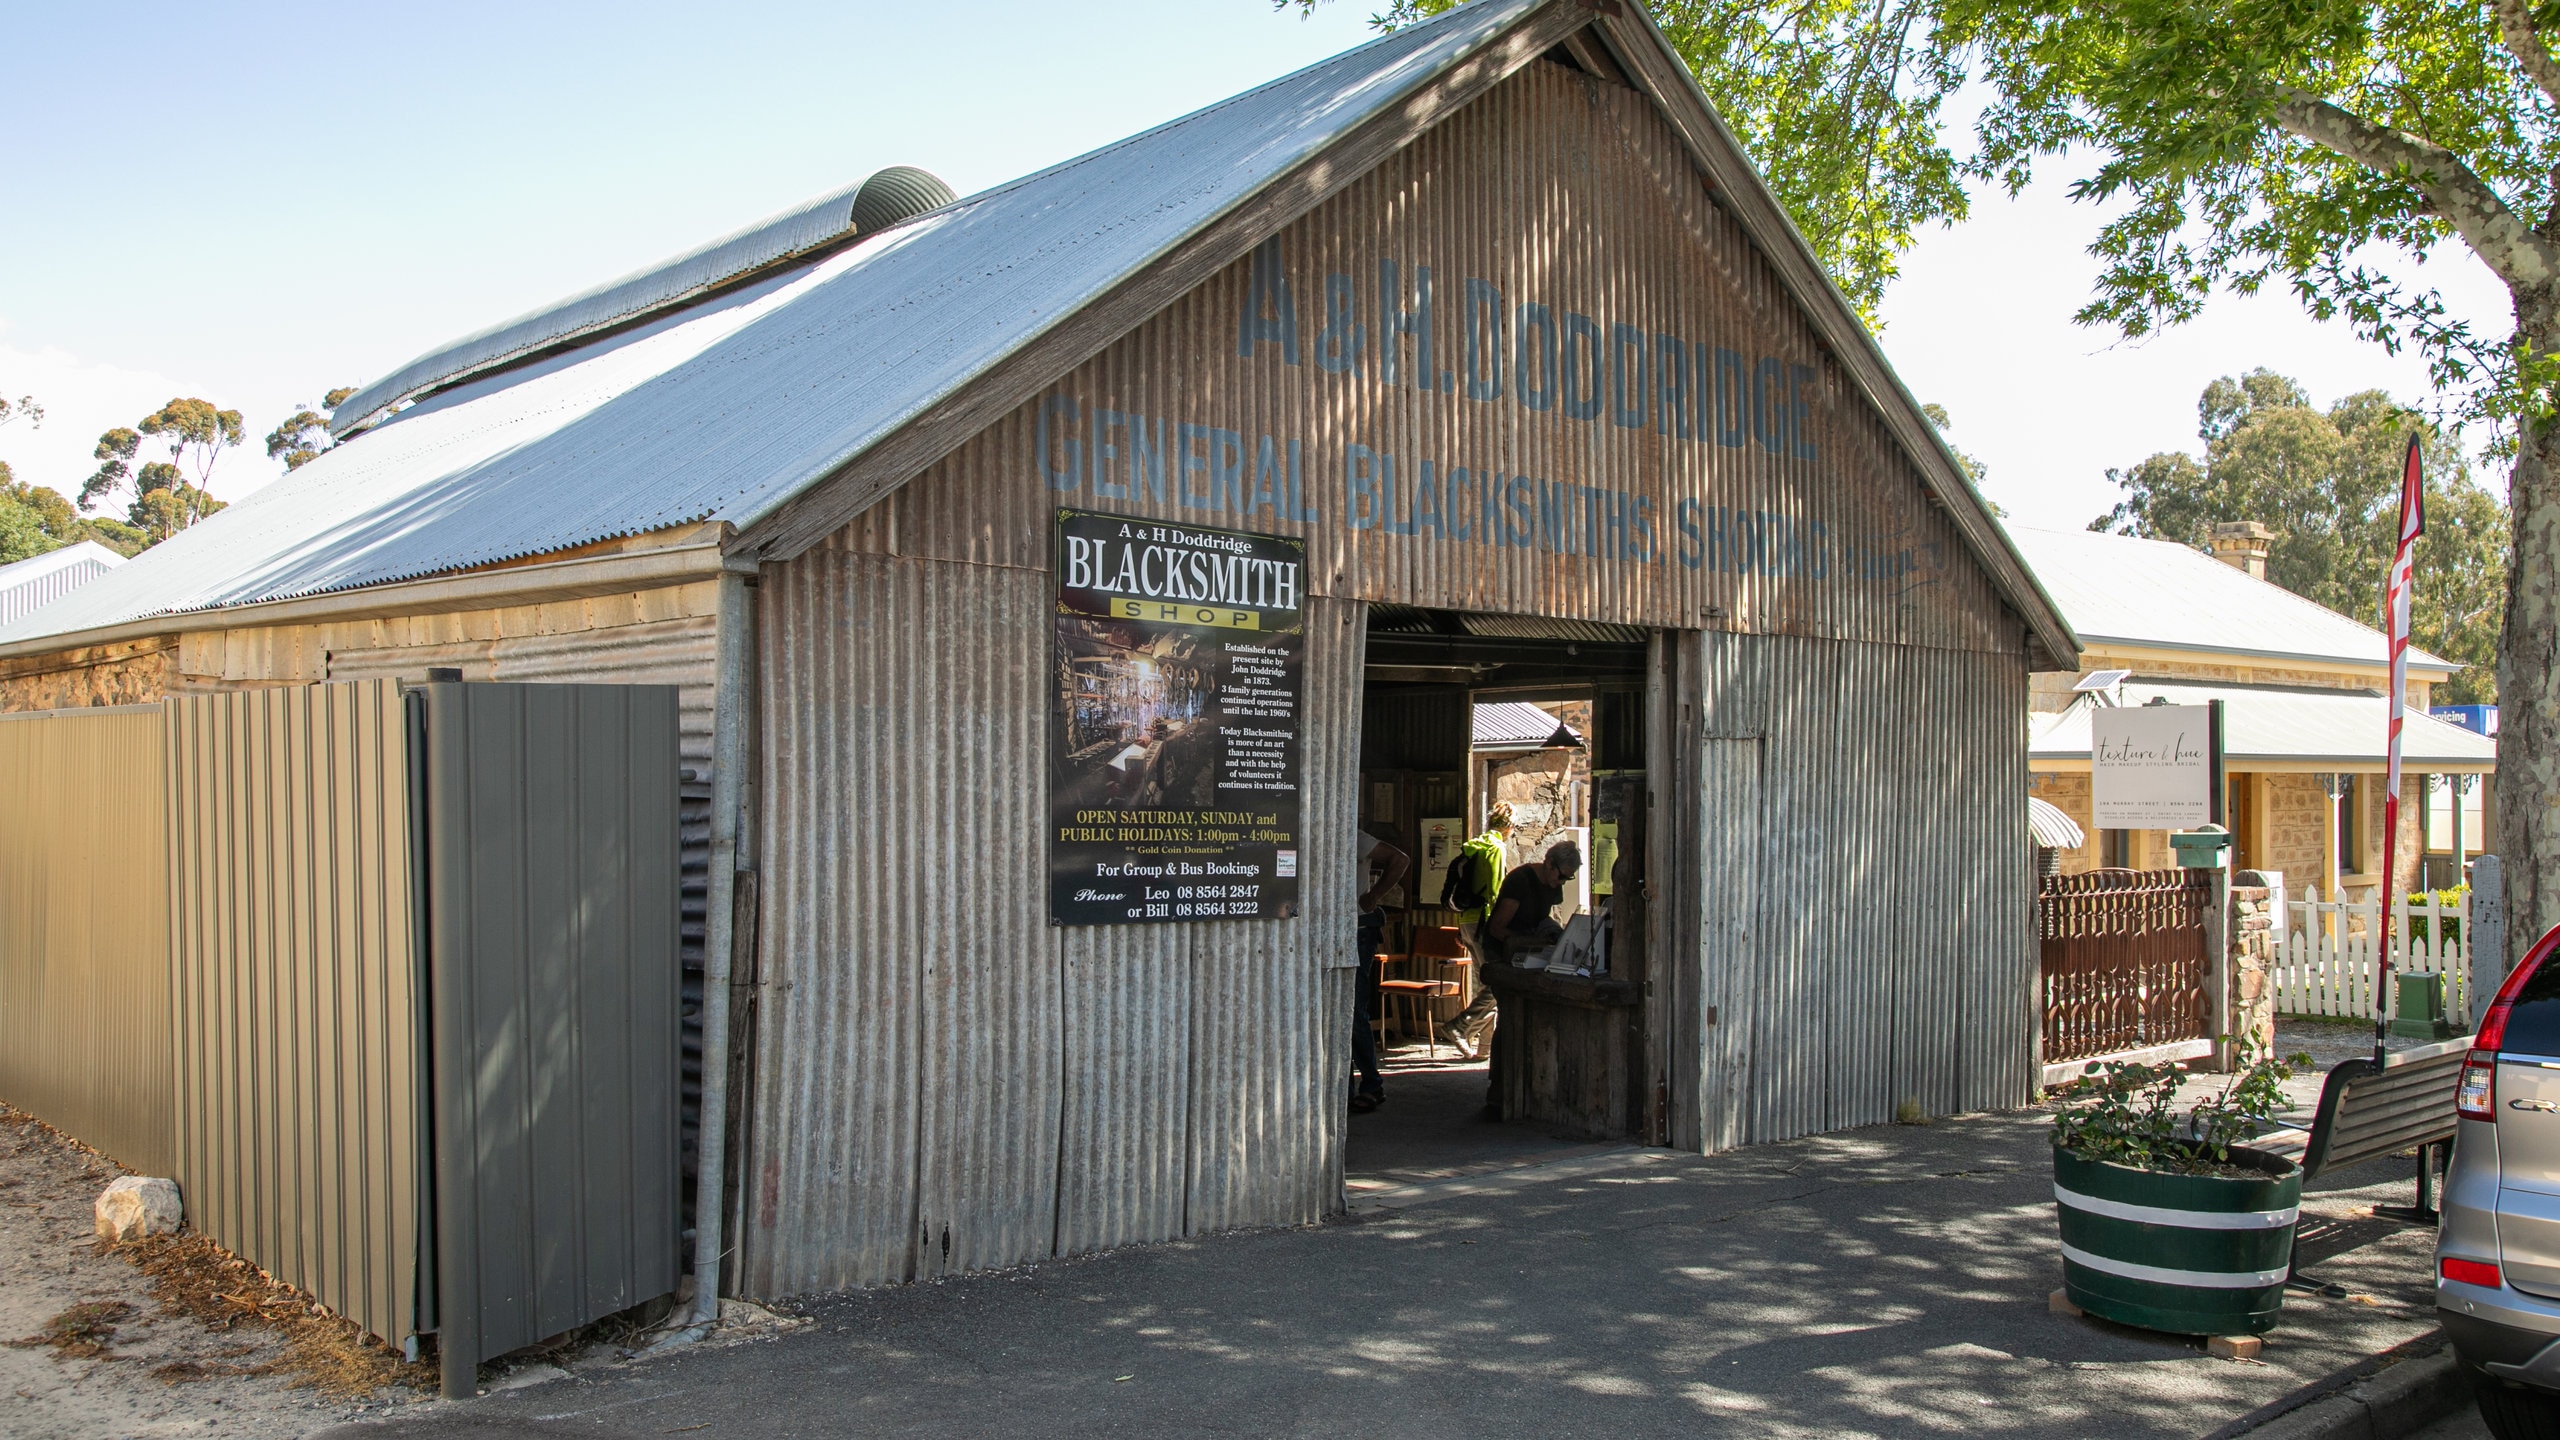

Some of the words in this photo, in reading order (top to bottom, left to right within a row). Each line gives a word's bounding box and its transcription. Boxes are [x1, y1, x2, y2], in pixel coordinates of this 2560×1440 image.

[1237, 232, 1299, 365] A
[1315, 272, 1367, 379] &
[1035, 394, 1318, 522] GENERAL
[1119, 524, 1131, 538] A
[1137, 529, 1148, 540] &
[1152, 527, 1167, 542] H
[1172, 530, 1252, 555] Doddridge
[1066, 535, 1297, 610] BLACKSMITH
[1125, 602, 1248, 626] SHOP
[1225, 643, 1266, 654] Established
[1232, 656, 1259, 664] present
[1260, 656, 1274, 665] site
[1275, 658, 1284, 667] by
[1231, 664, 1249, 674] John
[1250, 666, 1286, 677] Doddridge
[1244, 676, 1251, 684] in
[1253, 677, 1271, 685] 1873.
[1221, 685, 1226, 693] 3
[1228, 685, 1250, 695] family
[1251, 688, 1292, 697] generations
[1220, 696, 1255, 705] continued
[1257, 699, 1293, 707] operations
[1222, 706, 1239, 714] until
[1241, 707, 1253, 715] the
[1254, 708, 1268, 716] late
[1270, 709, 1291, 717] 1960's
[1219, 726, 1241, 737] Today
[1243, 728, 1293, 740] Blacksmithing
[1228, 737, 1234, 745] is
[2099, 736, 2157, 762] texture
[2174, 732, 2203, 762] hue
[1228, 748, 1244, 756] than
[1252, 750, 1284, 760] necessity
[1240, 759, 1256, 767] with
[1258, 760, 1270, 768] the
[1270, 760, 1286, 770] help
[1229, 769, 1237, 778] of
[1238, 770, 1275, 779] volunteers
[1276, 771, 1282, 779] it
[1218, 780, 1253, 789] continues
[1254, 781, 1263, 789] its
[1264, 781, 1296, 790] tradition.
[1077, 810, 1117, 824] OPEN
[1120, 811, 1198, 826] SATURDAY,
[1200, 811, 1254, 825] SUNDAY
[1256, 813, 1277, 825] and
[1060, 828, 1114, 841] PUBLIC
[1118, 828, 1193, 841] HOLIDAYS:
[1197, 829, 1239, 844] 1:00pm
[1249, 829, 1290, 844] 4:00pm
[1137, 846, 1159, 854] Gold
[1161, 846, 1182, 854] Coin
[1184, 845, 1223, 854] Donation
[1096, 863, 1120, 876] For
[1123, 862, 1162, 879] Group
[1165, 862, 1177, 875] &
[1180, 862, 1203, 875] Bus
[1206, 861, 1260, 877] Bookings
[1074, 888, 1127, 902] Phone
[1145, 886, 1170, 899] Leo
[1177, 885, 1193, 899] 08
[1196, 885, 1226, 898] 8564
[1230, 885, 1260, 898] 2847
[1127, 908, 1142, 917] or
[1146, 903, 1169, 917] Bill
[1176, 903, 1192, 916] 08
[1195, 902, 1225, 915] 8564
[1229, 901, 1258, 915] 3222
